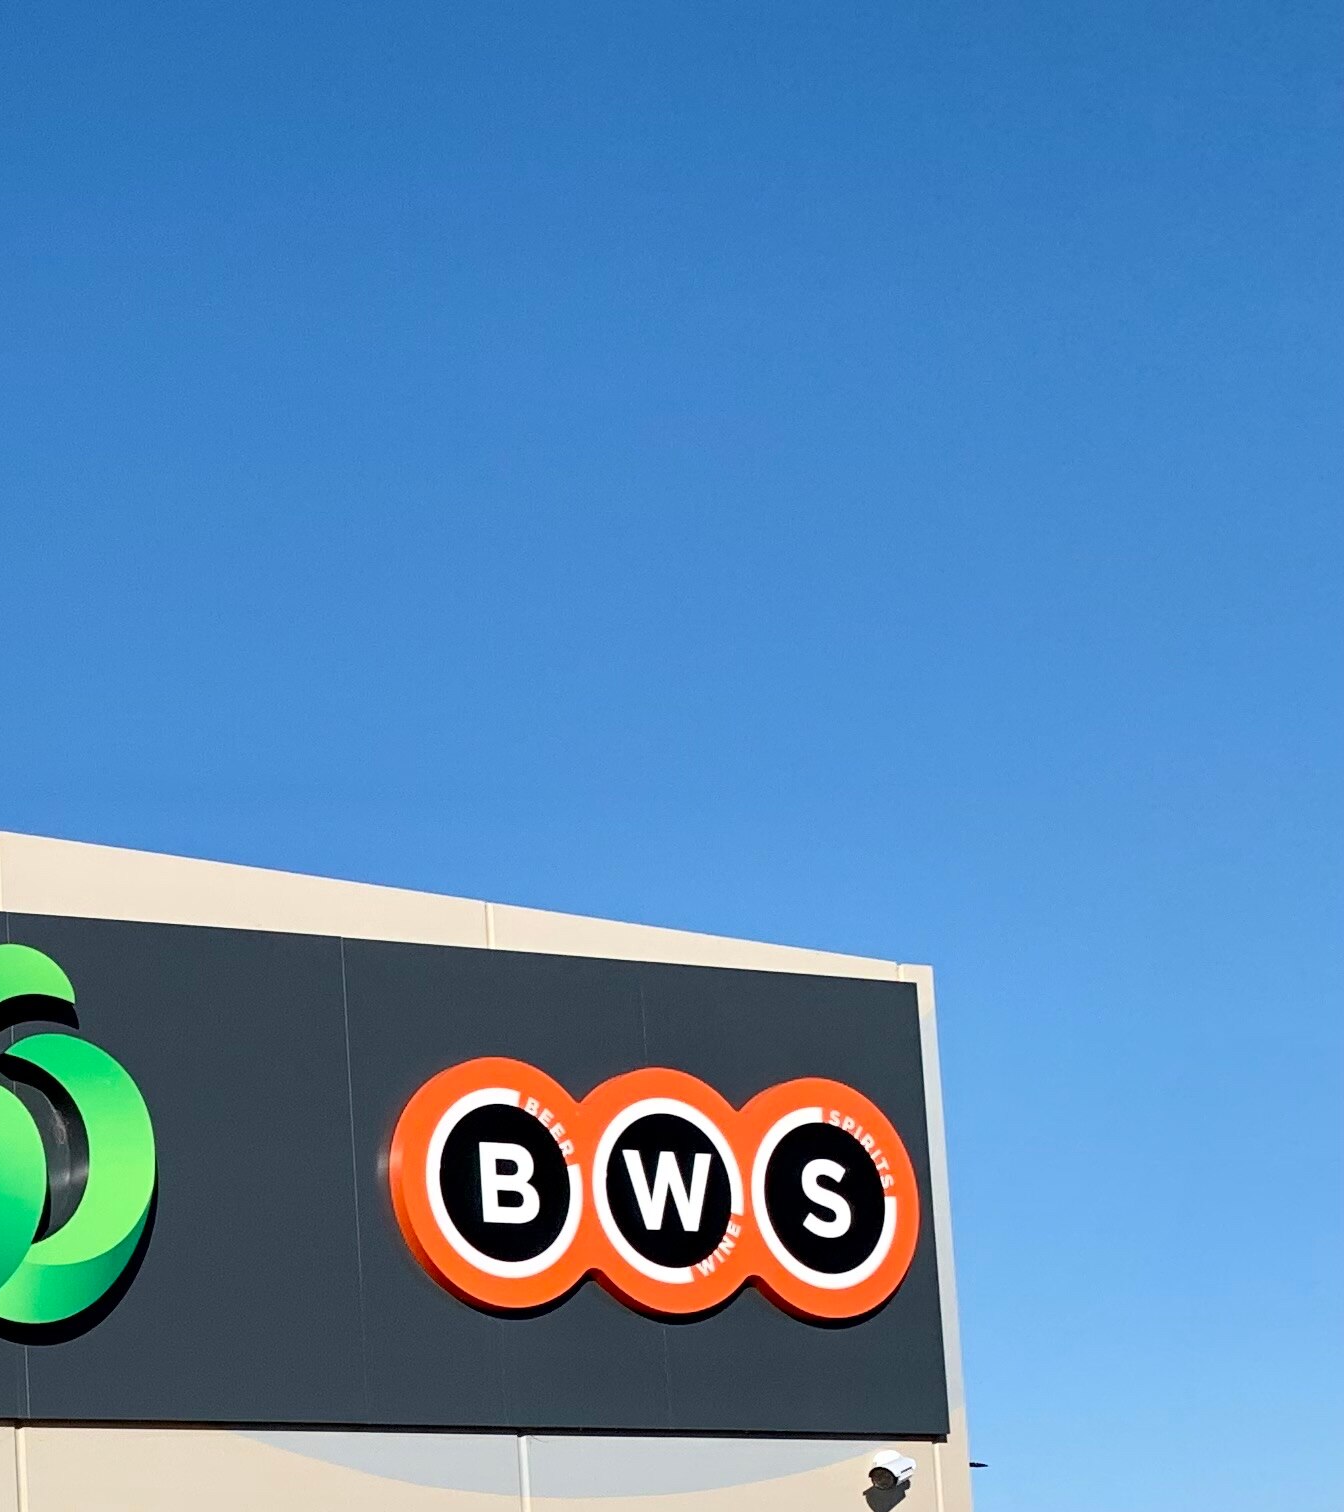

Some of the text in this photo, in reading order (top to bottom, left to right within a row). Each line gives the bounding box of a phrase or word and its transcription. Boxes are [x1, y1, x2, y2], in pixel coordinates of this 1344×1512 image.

[524, 1096, 575, 1158] BEER
[829, 1109, 895, 1189] SPIRITS
[695, 1220, 742, 1277] WINE
